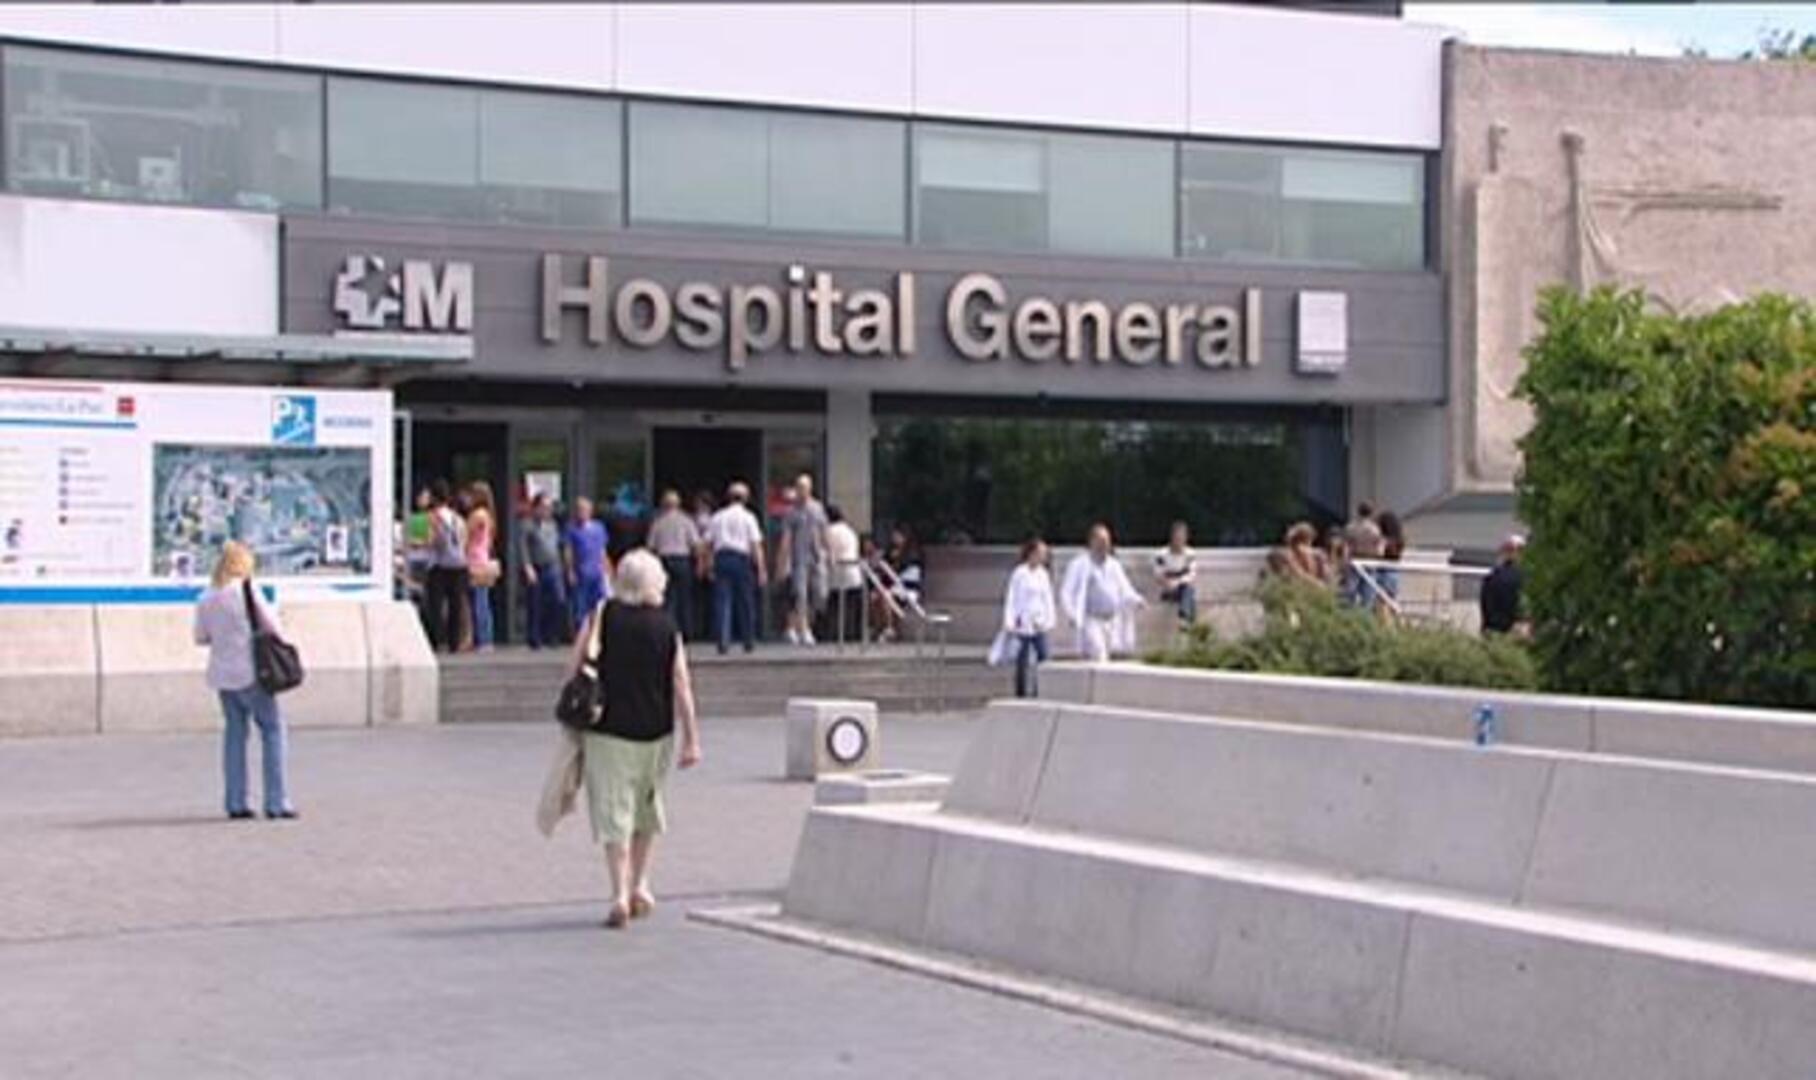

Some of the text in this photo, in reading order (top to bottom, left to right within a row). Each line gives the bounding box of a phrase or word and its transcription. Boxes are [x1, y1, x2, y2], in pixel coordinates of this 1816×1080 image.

[402, 260, 474, 329] M
[542, 254, 1262, 371] Hospital General
